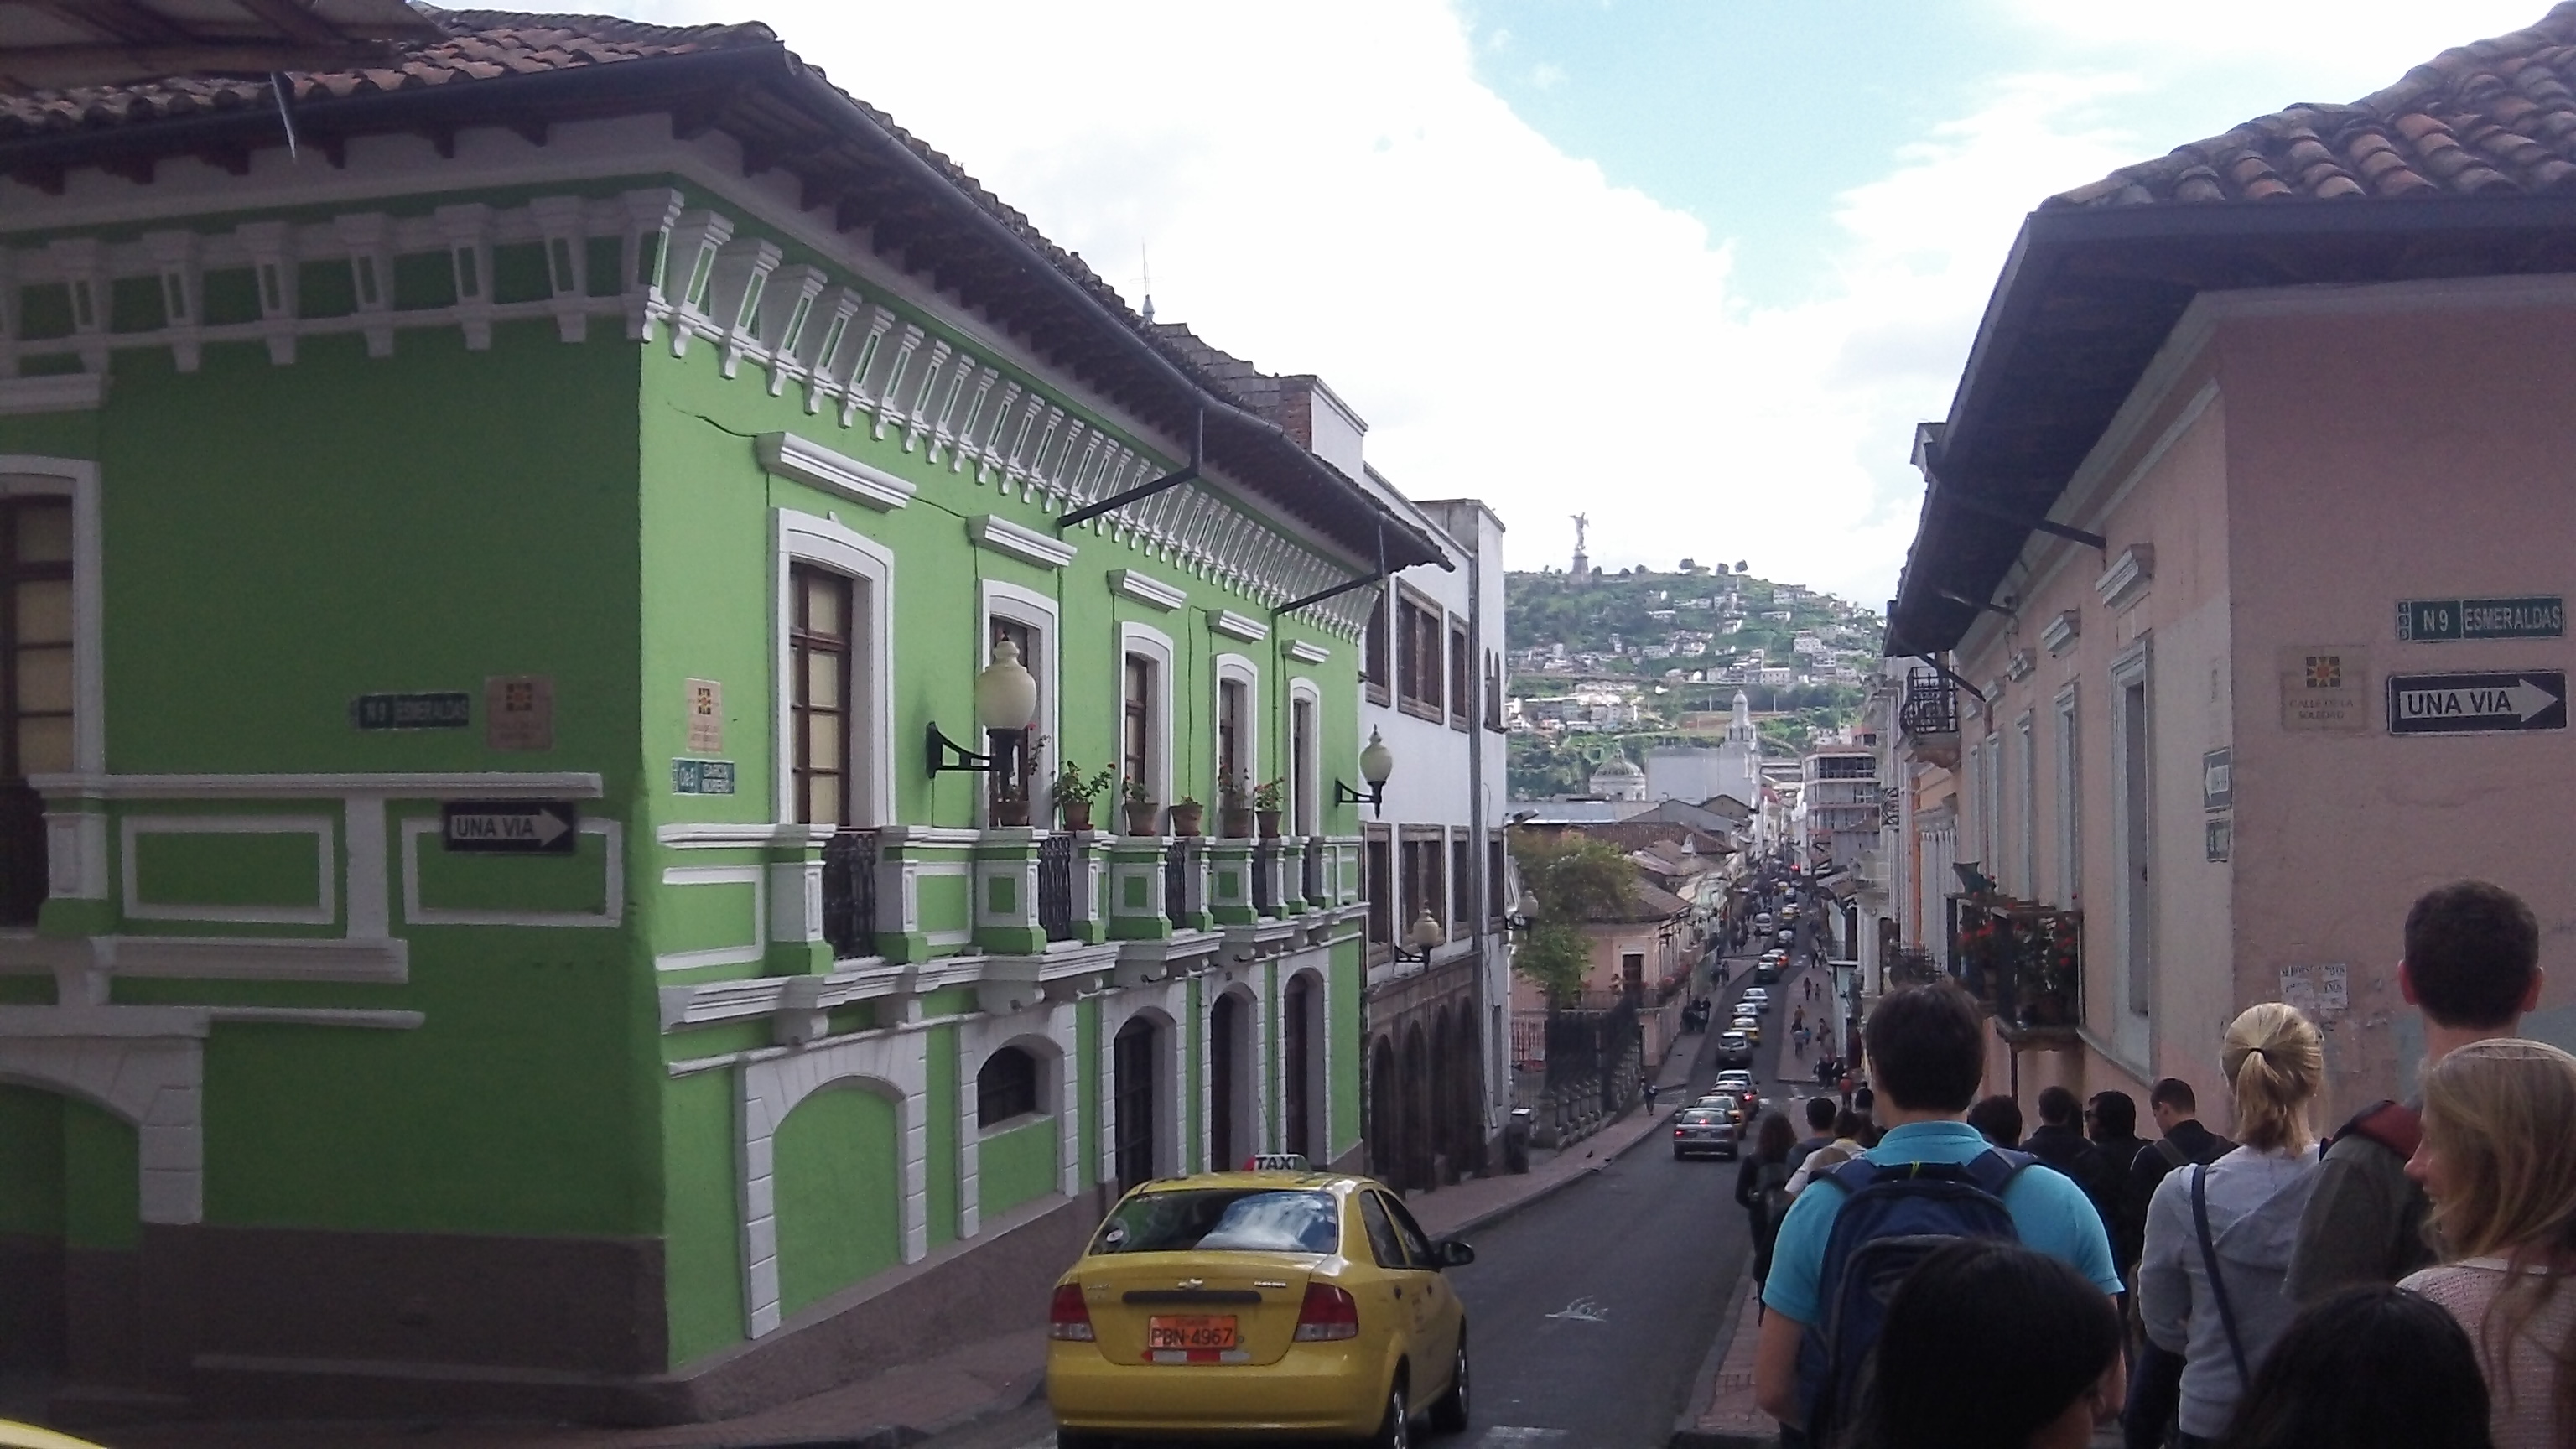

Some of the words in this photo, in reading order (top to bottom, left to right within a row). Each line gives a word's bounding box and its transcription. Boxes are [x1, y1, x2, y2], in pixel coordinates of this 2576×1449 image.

[2463, 605, 2562, 631] ESMERALDAS
[2407, 692, 2463, 716] UNA
[2470, 689, 2513, 714] VIA
[455, 818, 497, 838] UNA
[503, 817, 535, 837] VIA
[1255, 1156, 1297, 1171] TAXI
[1150, 1327, 1233, 1347] PBN-4967
